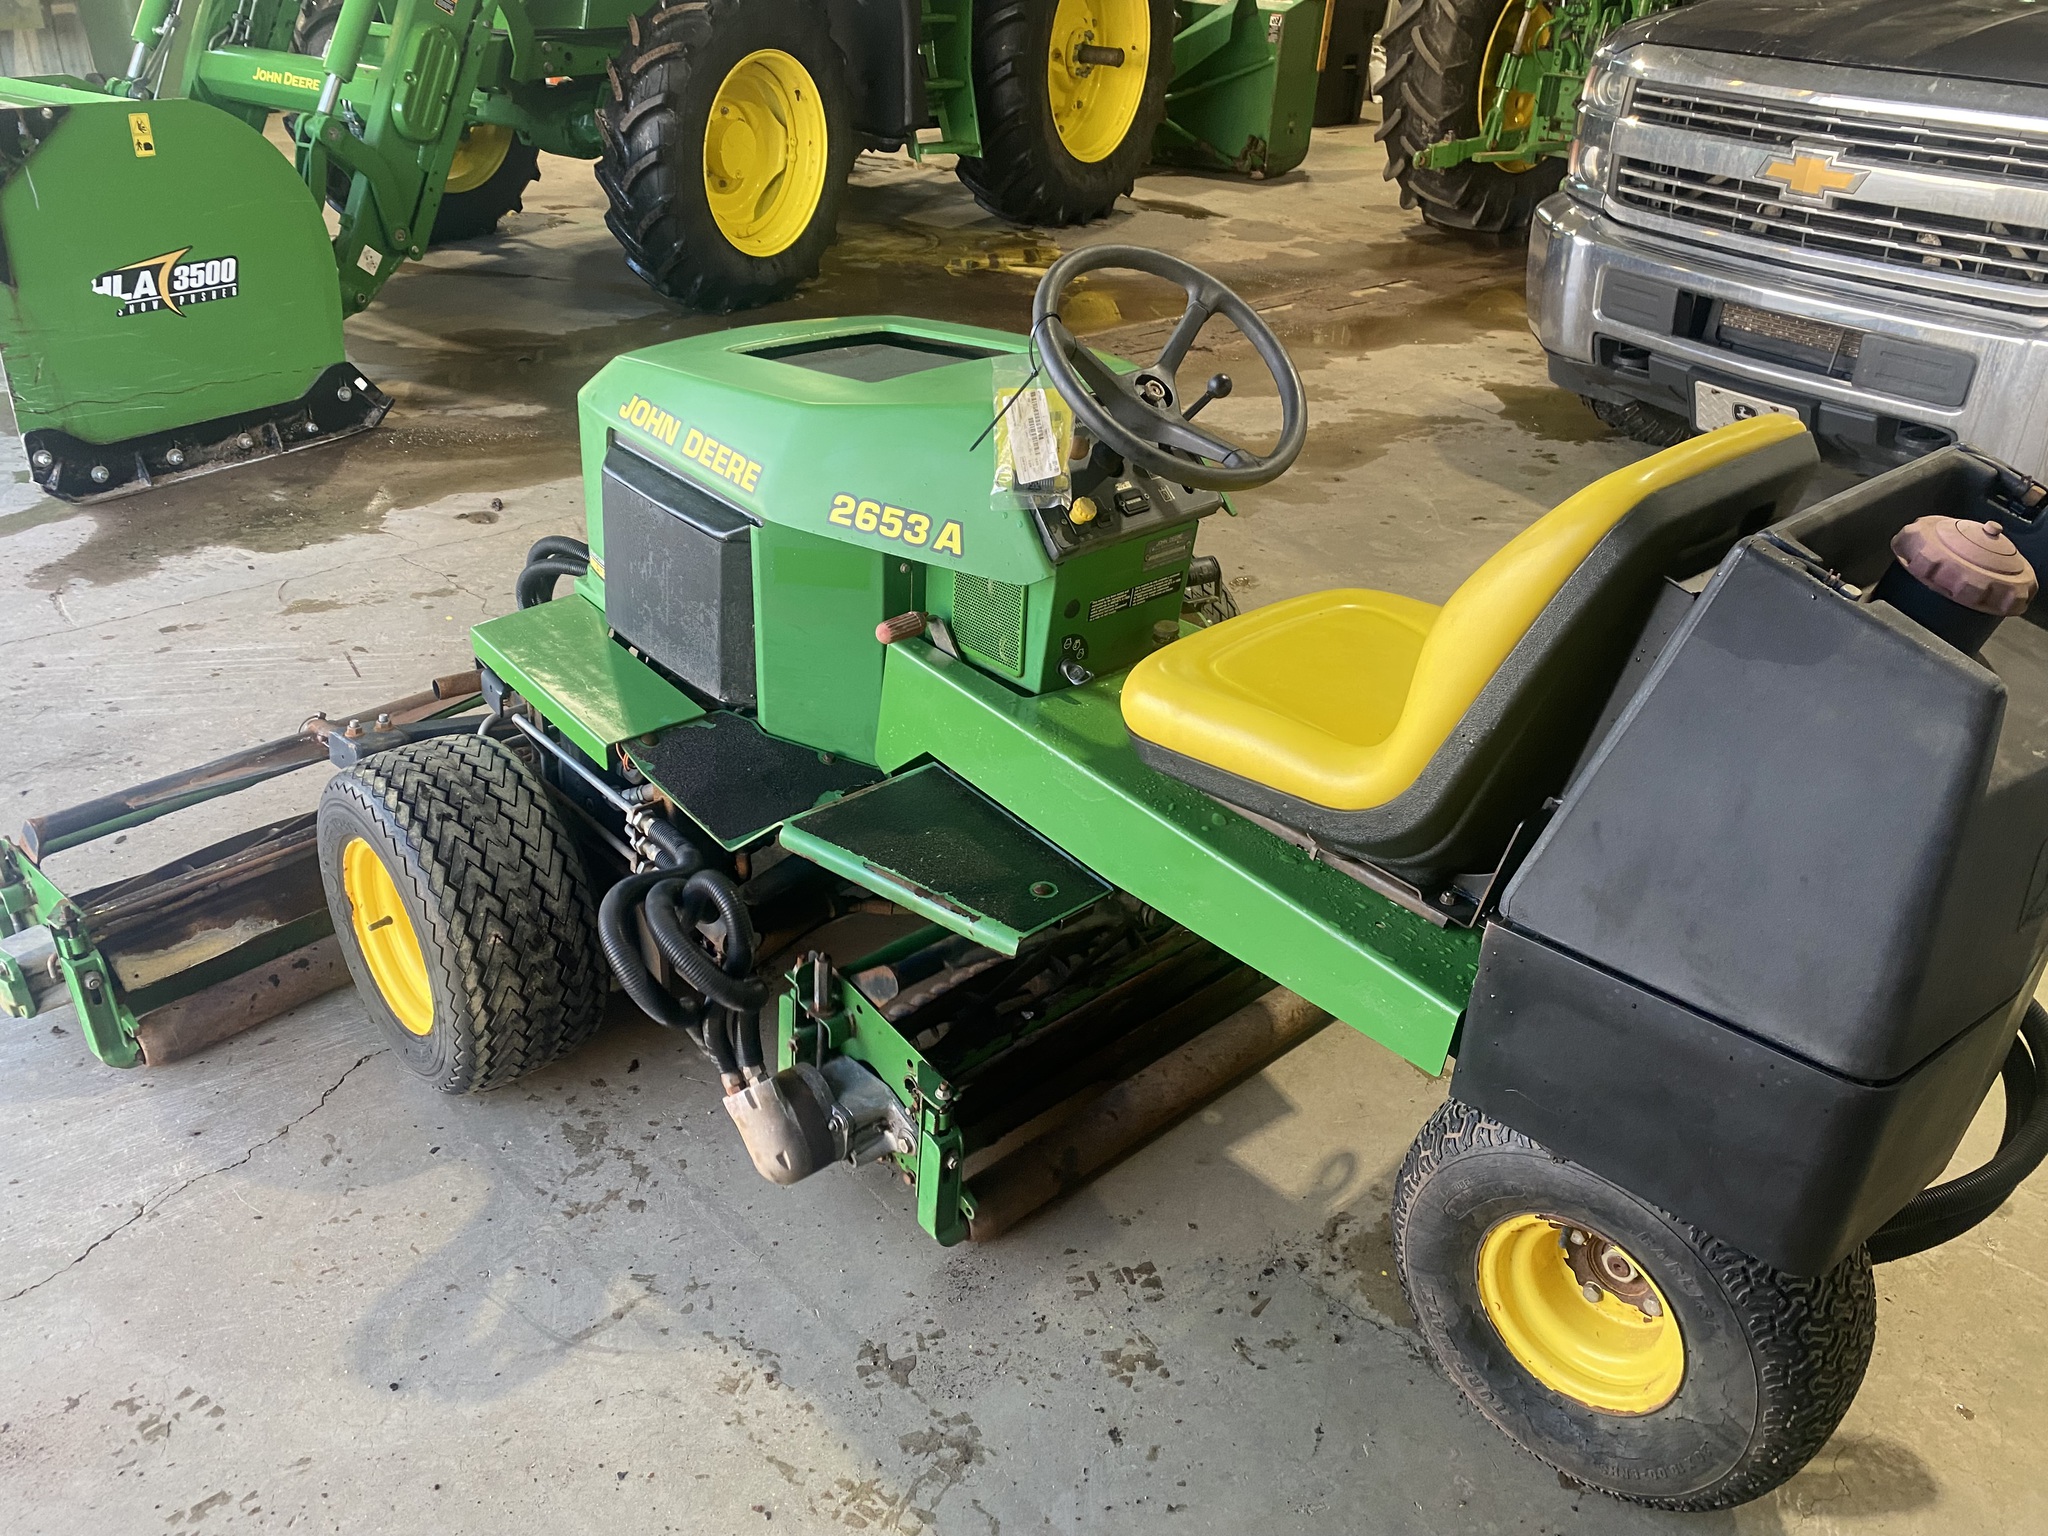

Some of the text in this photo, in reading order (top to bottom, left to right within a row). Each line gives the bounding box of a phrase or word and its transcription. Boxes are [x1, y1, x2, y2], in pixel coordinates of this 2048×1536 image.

[252, 67, 321, 91] JOHN DEERE
[173, 257, 237, 291] 3500
[179, 287, 237, 306] PUSHER
[619, 395, 762, 493] JOHN DEERE
